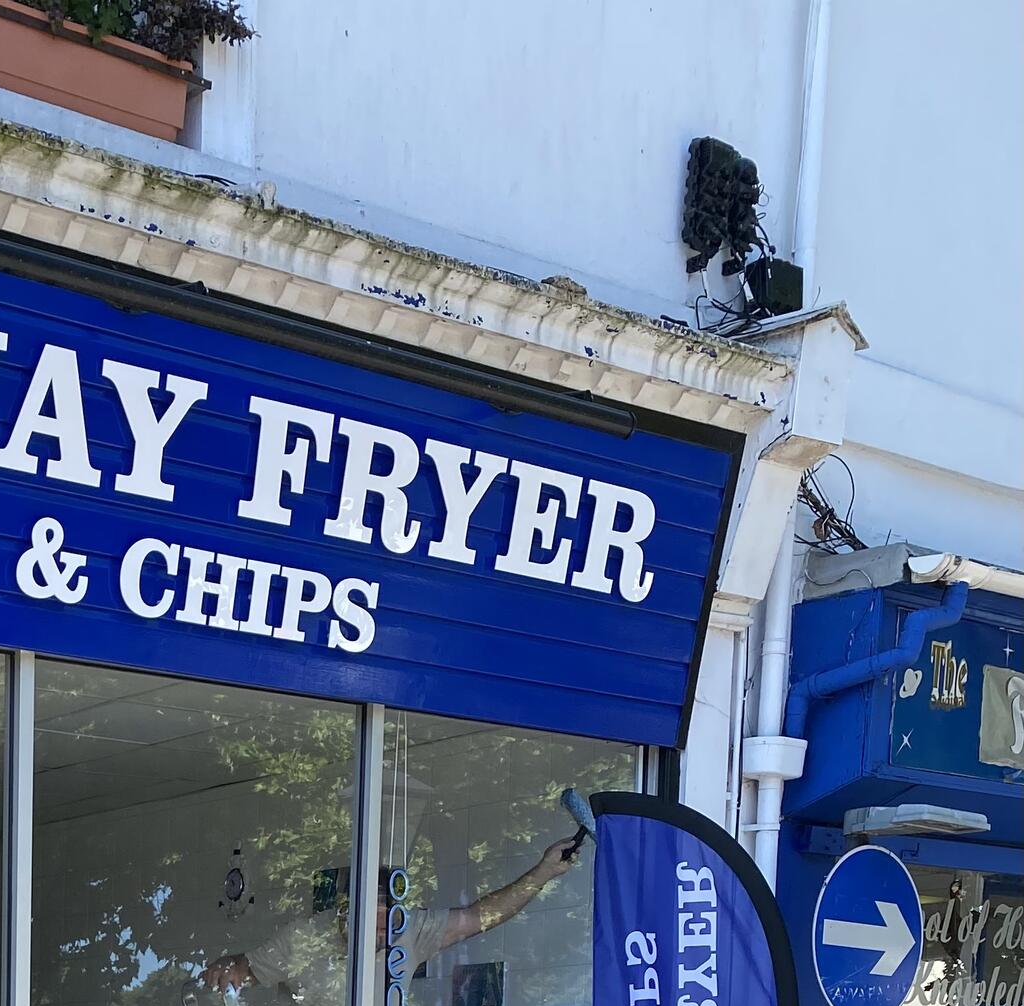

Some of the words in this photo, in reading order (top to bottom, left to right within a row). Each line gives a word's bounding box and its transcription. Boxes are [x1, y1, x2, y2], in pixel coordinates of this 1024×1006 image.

[237, 395, 656, 603] FRYER
[15, 516, 89, 604] &
[119, 537, 380, 653] CHIPS
[930, 640, 968, 702] The
[922, 899, 952, 943] ol
